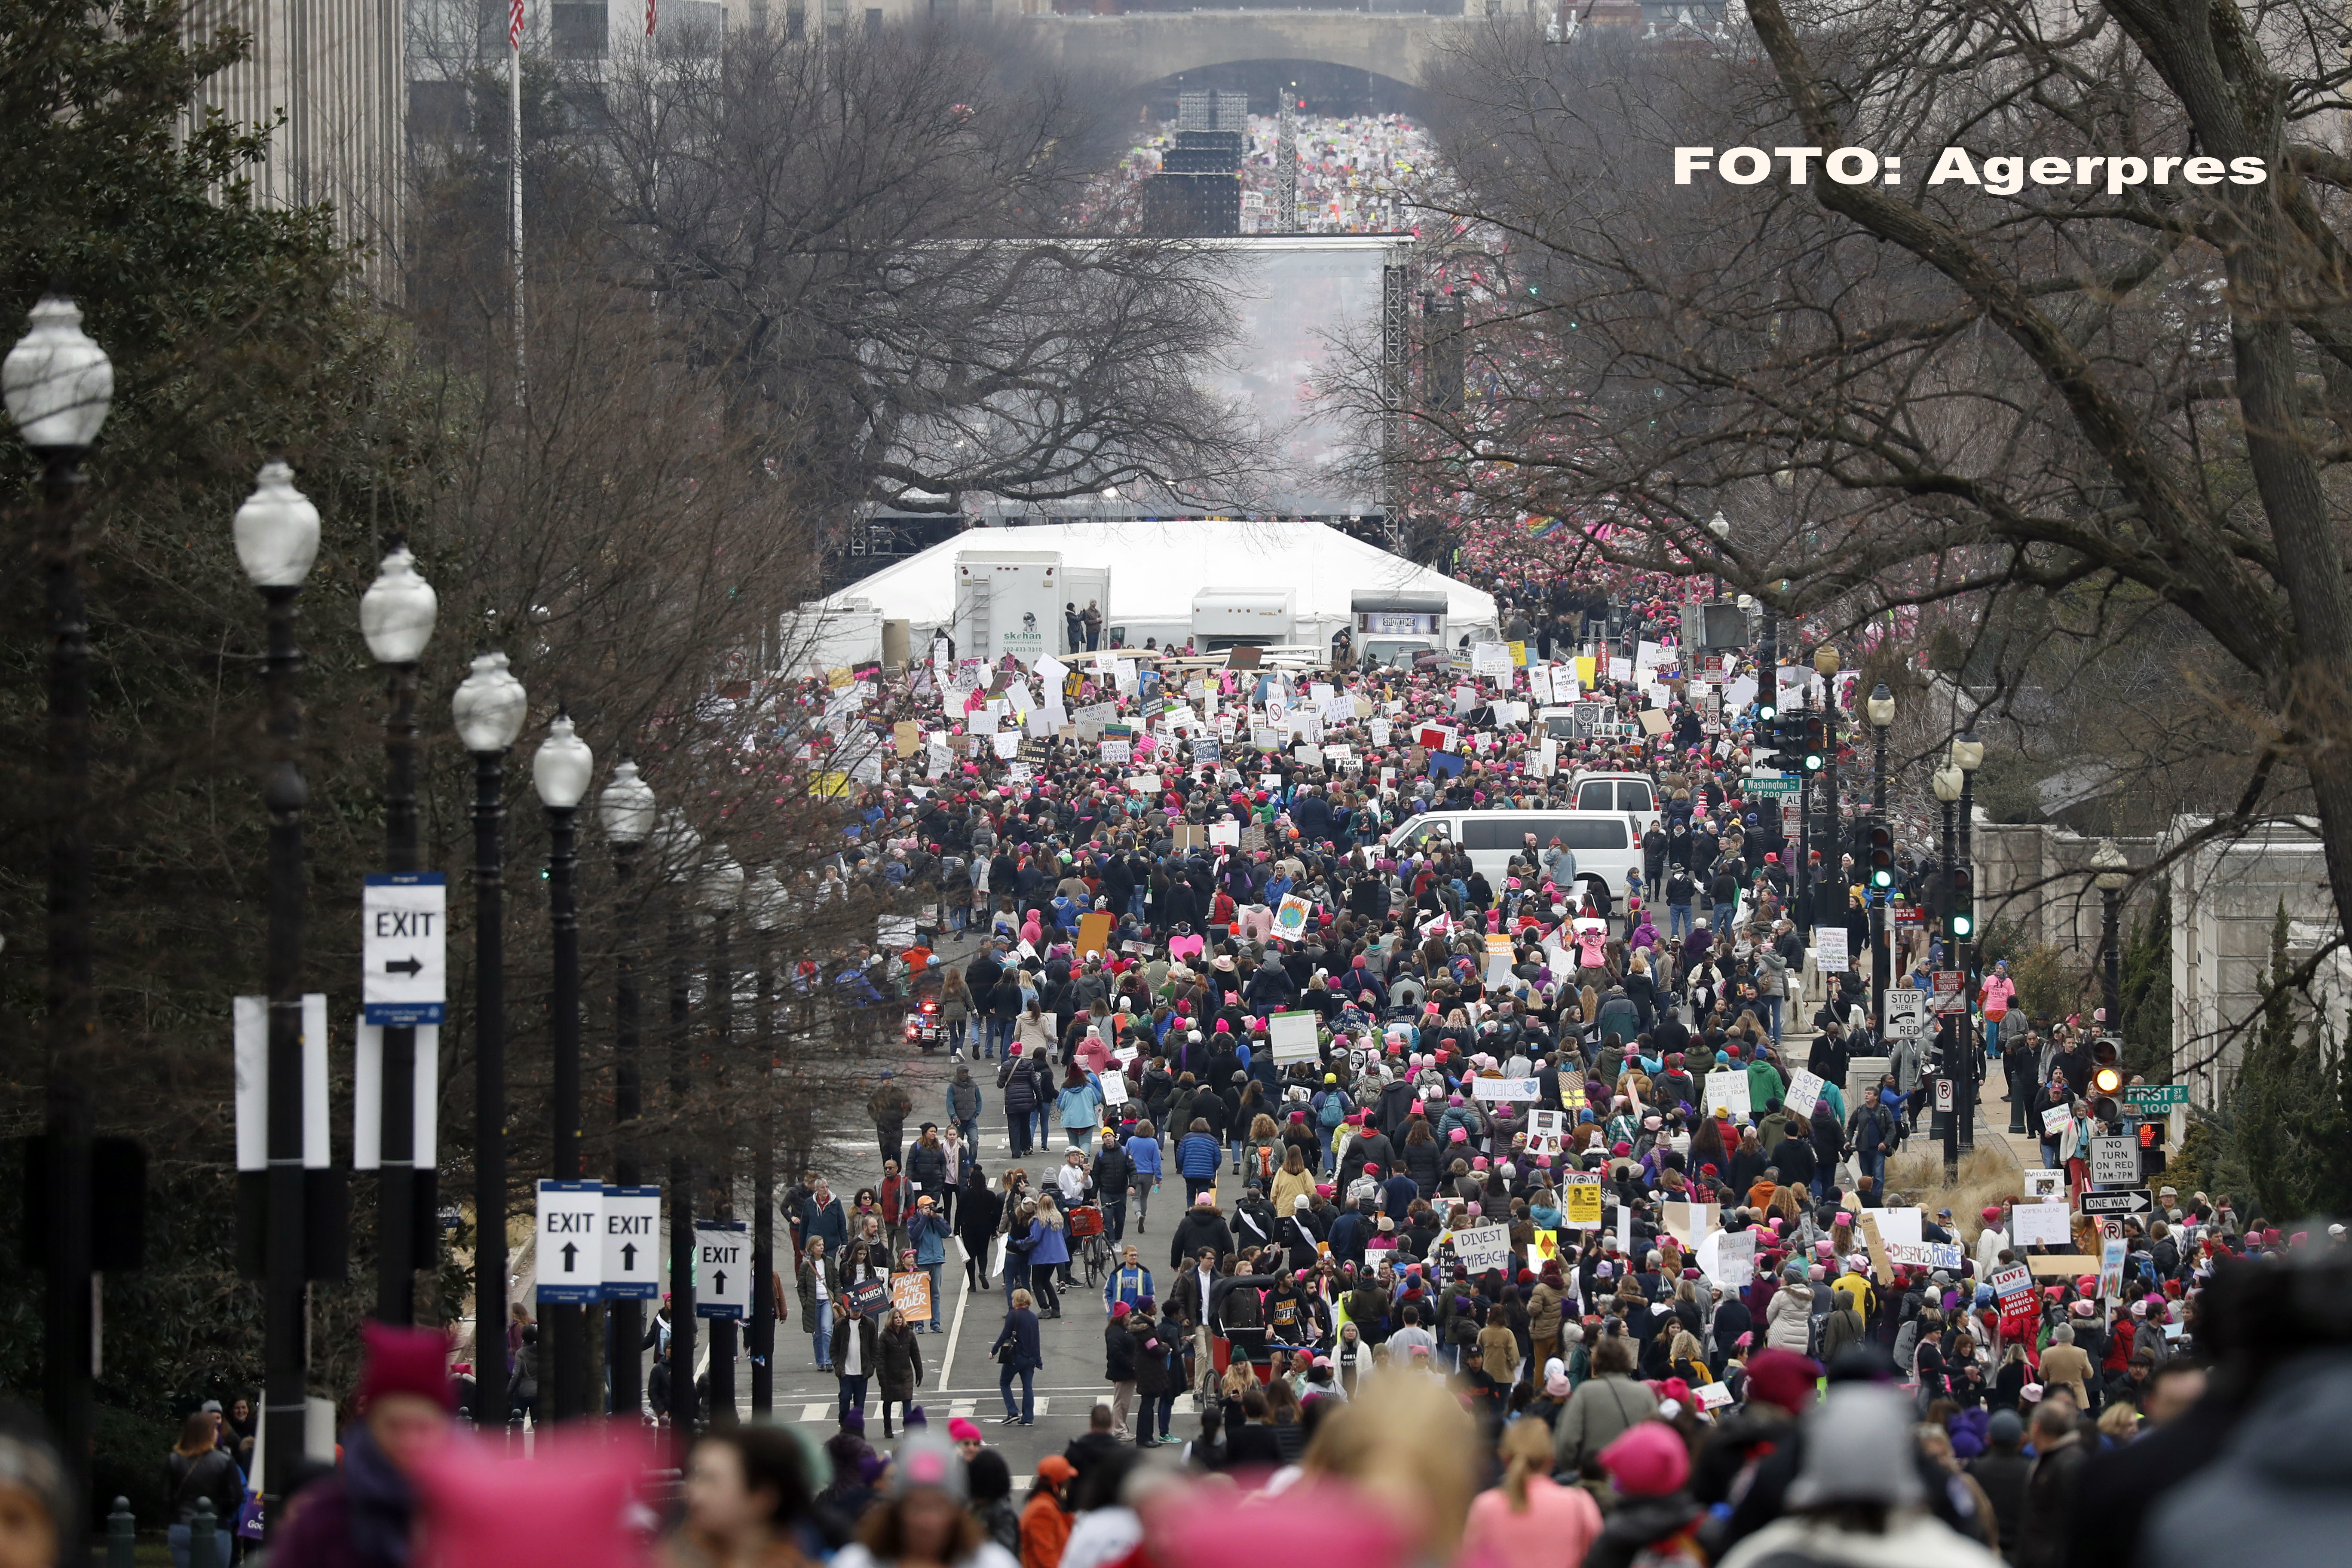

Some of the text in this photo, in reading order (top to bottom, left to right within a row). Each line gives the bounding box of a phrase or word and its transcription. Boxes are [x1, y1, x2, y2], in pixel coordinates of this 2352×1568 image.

[1384, 617, 1415, 626] SHOWTIME
[1329, 697, 1348, 707] LOVE
[1331, 710, 1349, 721] HATE
[934, 745, 952, 754] EMBRACE
[1195, 741, 1218, 750] EQUALITY
[1196, 747, 1216, 756] NOW
[1748, 780, 1788, 790] Washington
[376, 912, 435, 937] EXIT
[1281, 928, 1300, 938] PLANET
[1891, 994, 1918, 1003] STOP
[1900, 1026, 1920, 1035] RED
[1797, 1071, 1820, 1090] LOVE
[1789, 1087, 1816, 1108] PEACE
[2128, 1088, 2170, 1101] FIRST
[2142, 1104, 2171, 1113] 100
[2089, 1197, 2131, 1208] ONE WAY
[548, 1213, 594, 1233] EXIT
[608, 1215, 652, 1234] EXIT
[1461, 1229, 1503, 1247] DIVEST
[703, 1246, 740, 1264] EXIT
[1891, 1244, 1921, 1261] DISSENT
[1459, 1250, 1508, 1269] IMPEACH
[1996, 1268, 2026, 1285] LOVE
[858, 1283, 879, 1293] WOMEN'S
[894, 1273, 928, 1292] FIGHT
[2012, 1279, 2025, 1288] HATE
[859, 1288, 883, 1301] MARCH
[904, 1285, 921, 1295] THE
[896, 1292, 927, 1310] POWER
[2005, 1291, 2028, 1302] MAKES
[2004, 1298, 2035, 1311] AMERICA
[2010, 1305, 2032, 1317] GREAT
